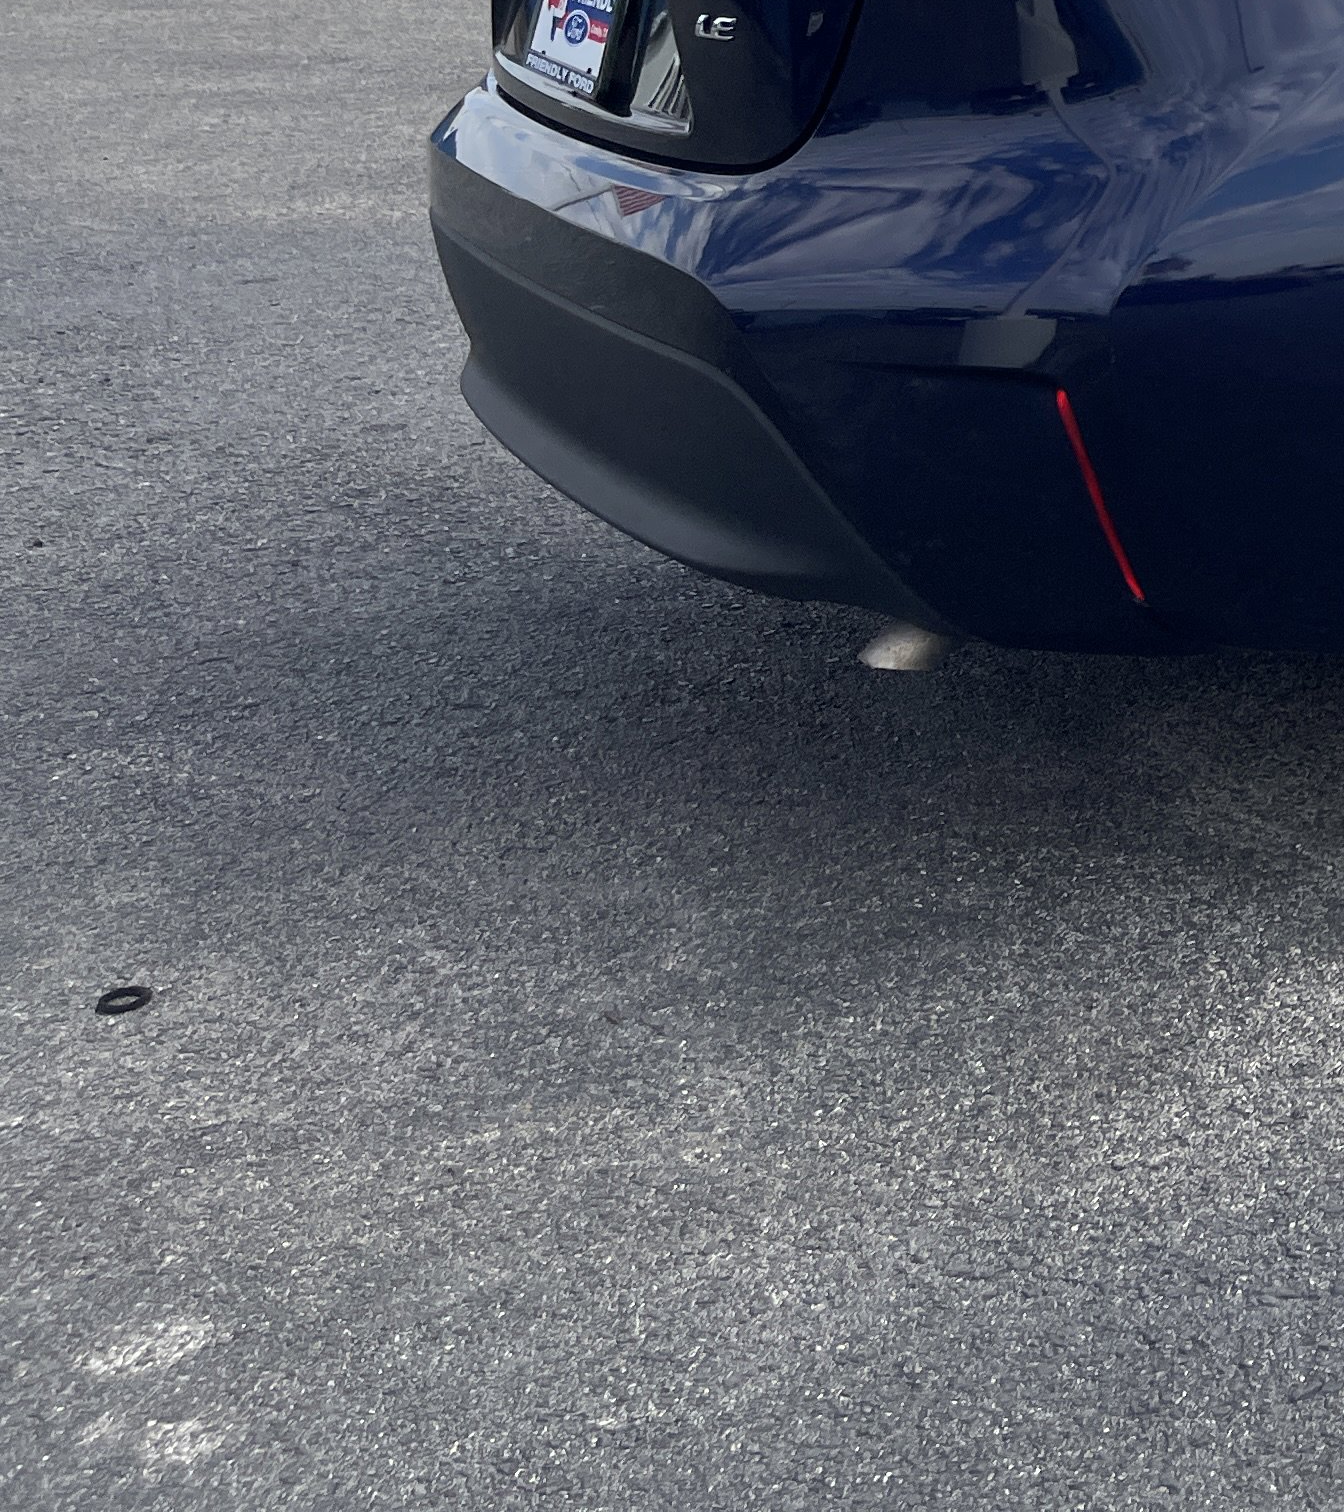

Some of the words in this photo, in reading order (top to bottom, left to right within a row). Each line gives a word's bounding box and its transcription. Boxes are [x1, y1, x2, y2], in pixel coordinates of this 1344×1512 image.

[694, 14, 738, 41] LE
[525, 53, 568, 80] FRIENDLY
[567, 72, 595, 94] FORD
